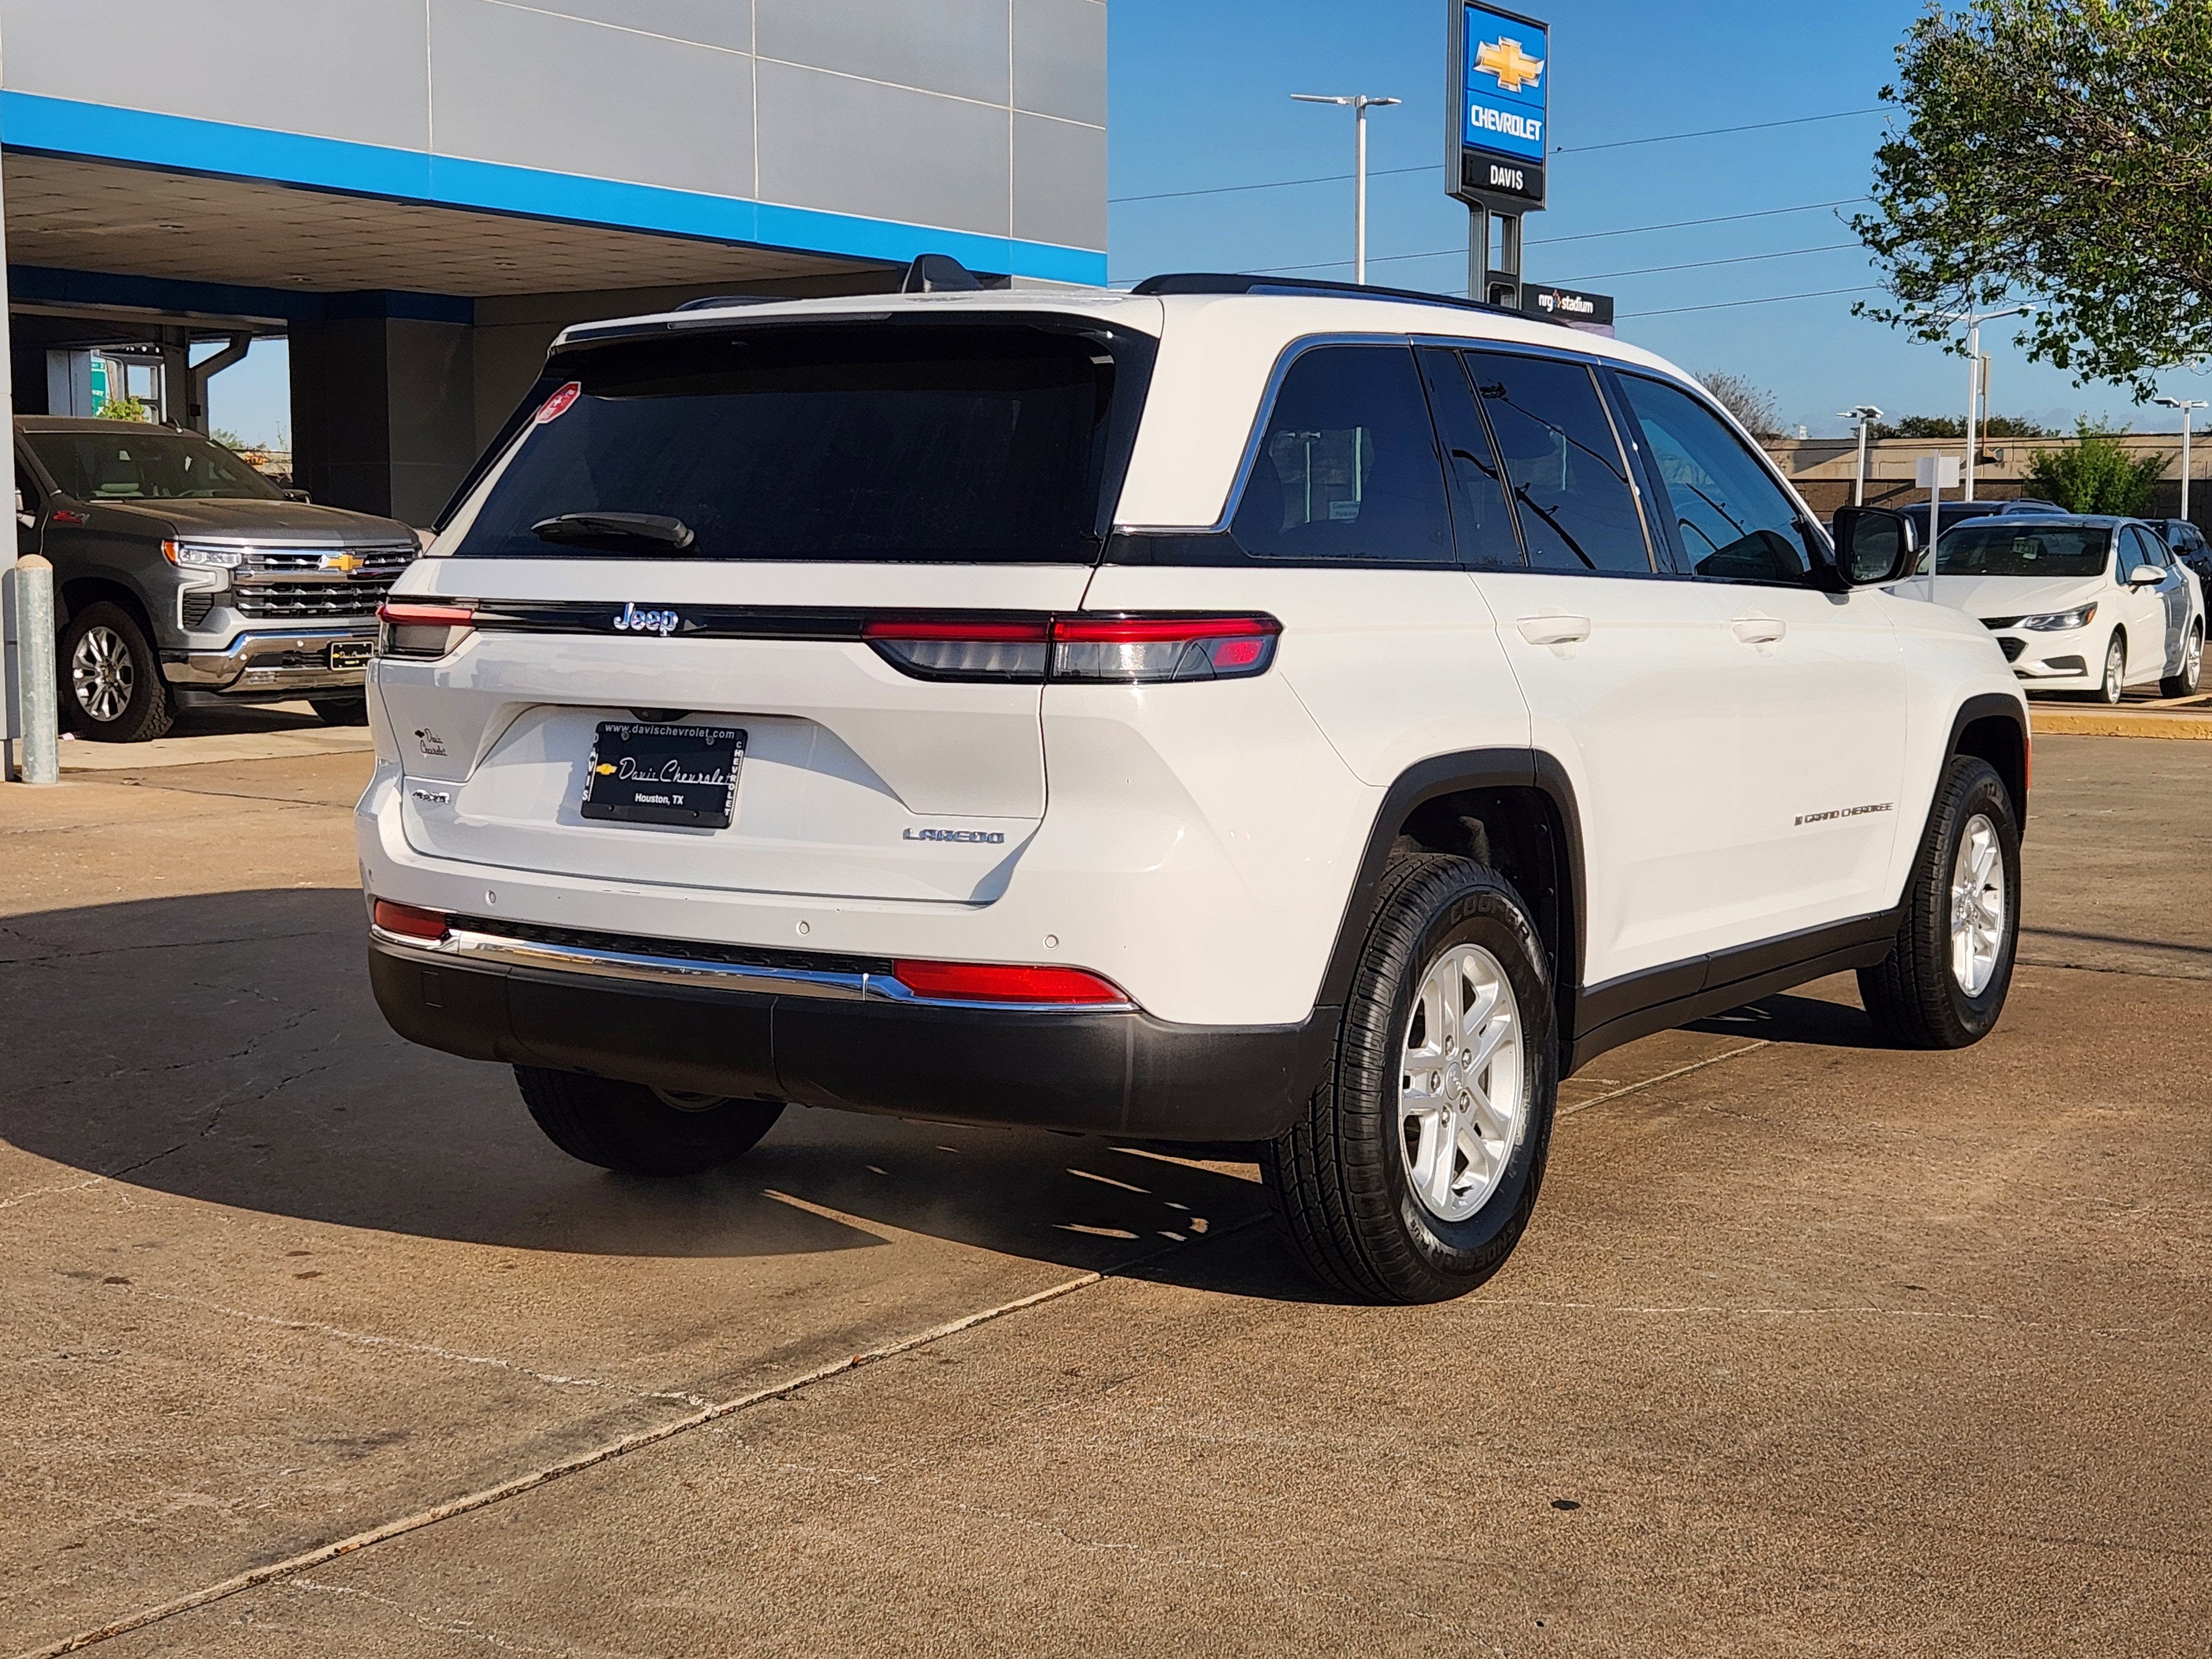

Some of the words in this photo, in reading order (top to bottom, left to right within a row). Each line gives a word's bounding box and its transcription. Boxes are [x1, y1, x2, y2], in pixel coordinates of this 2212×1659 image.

[1471, 105, 1542, 142] CHEVROLET
[1490, 165, 1524, 191] DAVIS
[1538, 294, 1553, 312] nrg
[1562, 295, 1594, 314] stadium
[613, 602, 679, 636] Jeep
[605, 724, 735, 739] www.davischevrolet.com
[635, 793, 671, 804] Houston,
[672, 795, 684, 805] TX
[902, 827, 1005, 844] LAREDO
